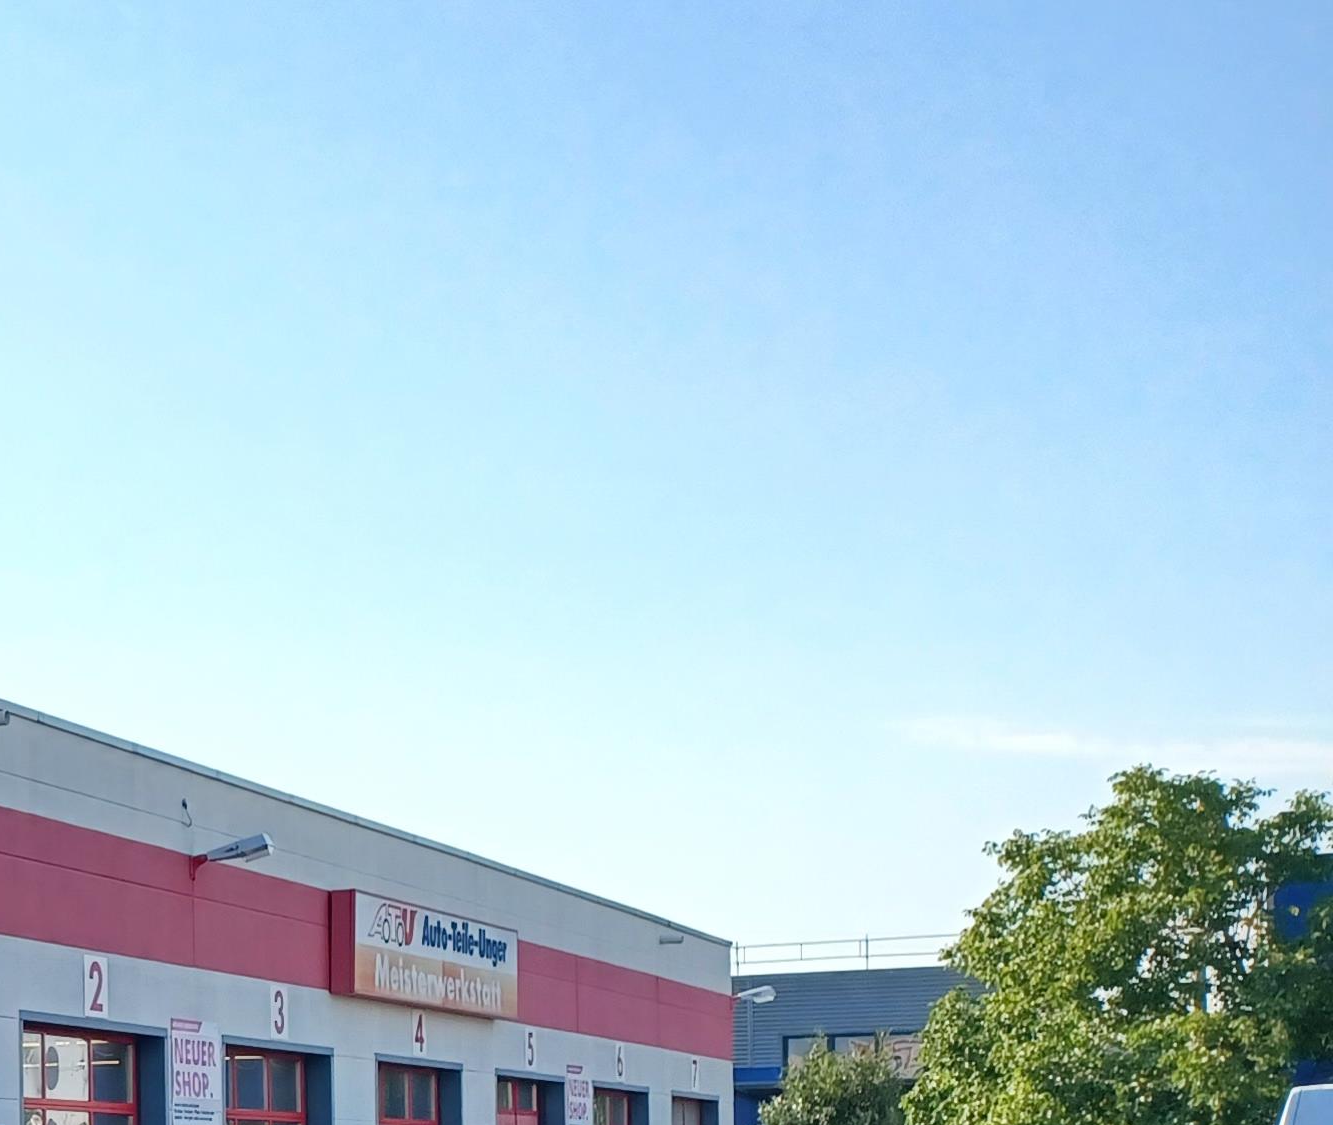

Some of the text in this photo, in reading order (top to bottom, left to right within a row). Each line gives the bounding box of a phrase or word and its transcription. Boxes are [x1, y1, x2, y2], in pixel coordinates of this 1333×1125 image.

[421, 915, 507, 967] Auto-Teile-Unger
[89, 961, 103, 1012] 2
[374, 952, 502, 1012] Meisterwerkstatt
[274, 990, 284, 1034] 3
[414, 1014, 425, 1052] 4
[527, 1032, 534, 1066] 5
[174, 1037, 217, 1067] NEUER
[617, 1046, 623, 1077] 6
[175, 1070, 214, 1099] SHOP.
[692, 1059, 698, 1088] 7
